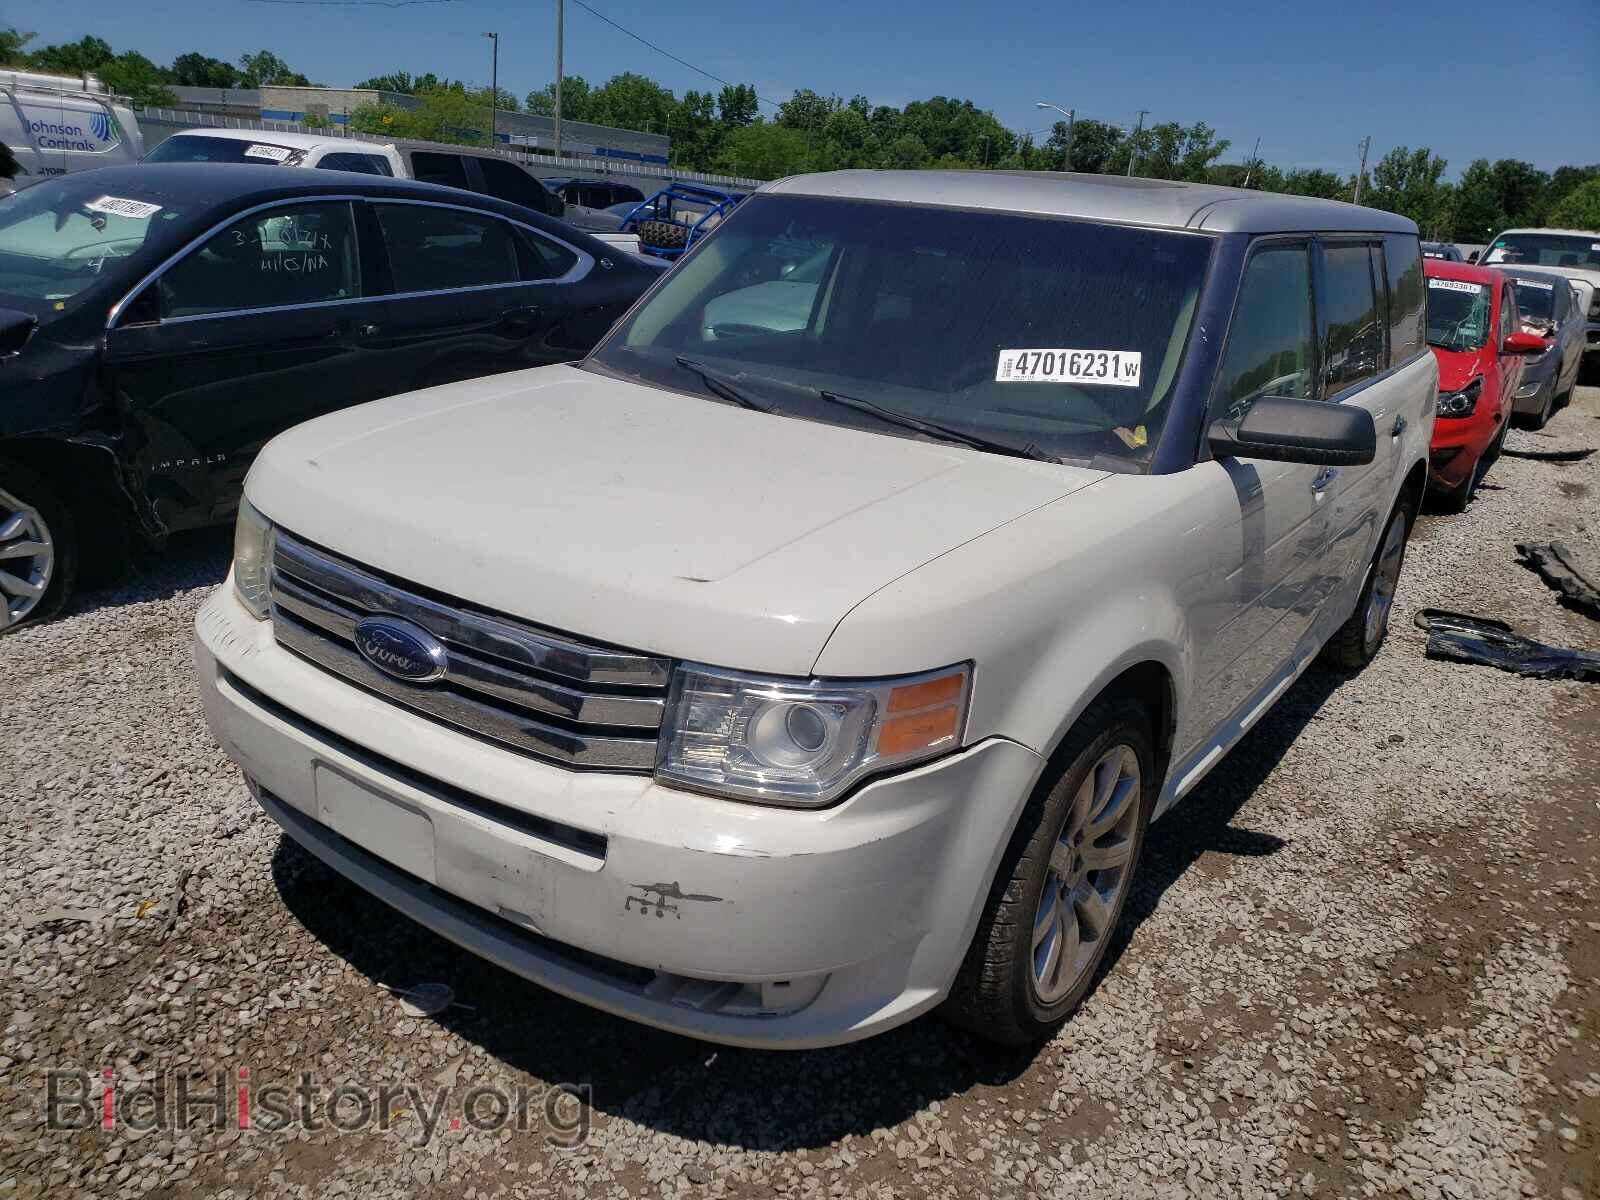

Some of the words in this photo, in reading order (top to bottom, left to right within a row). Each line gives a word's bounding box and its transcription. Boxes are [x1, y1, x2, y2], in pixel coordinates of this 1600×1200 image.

[22, 118, 83, 137] Johnson
[38, 135, 96, 152] Controls
[1015, 351, 1120, 378] 47016231
[1125, 362, 1138, 377] W
[151, 453, 227, 471] IMPALA
